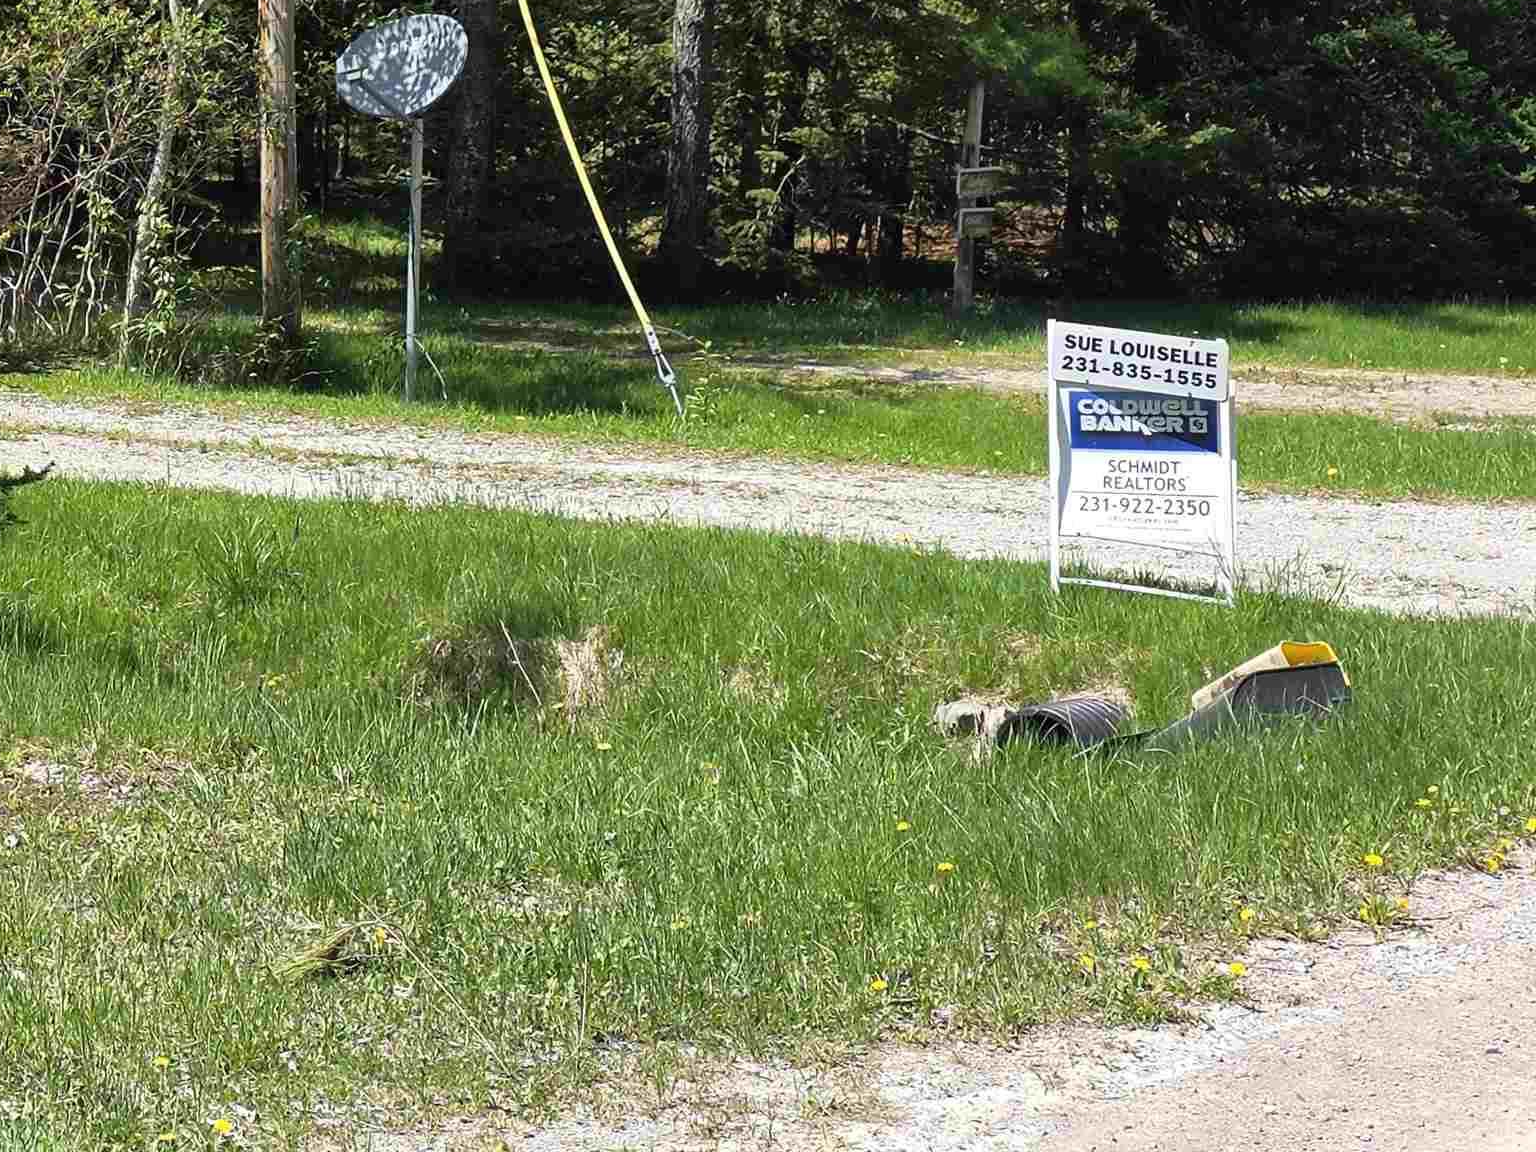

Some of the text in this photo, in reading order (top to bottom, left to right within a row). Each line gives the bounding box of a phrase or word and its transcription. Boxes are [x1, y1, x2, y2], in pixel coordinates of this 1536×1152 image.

[1064, 334, 1218, 368] SUE LOUISELLE
[1062, 356, 1217, 389] 231-835-1555
[1108, 460, 1180, 474] SCHMIDT
[1103, 476, 1186, 491] REALTORS
[1079, 496, 1211, 516] 231-922-2350
